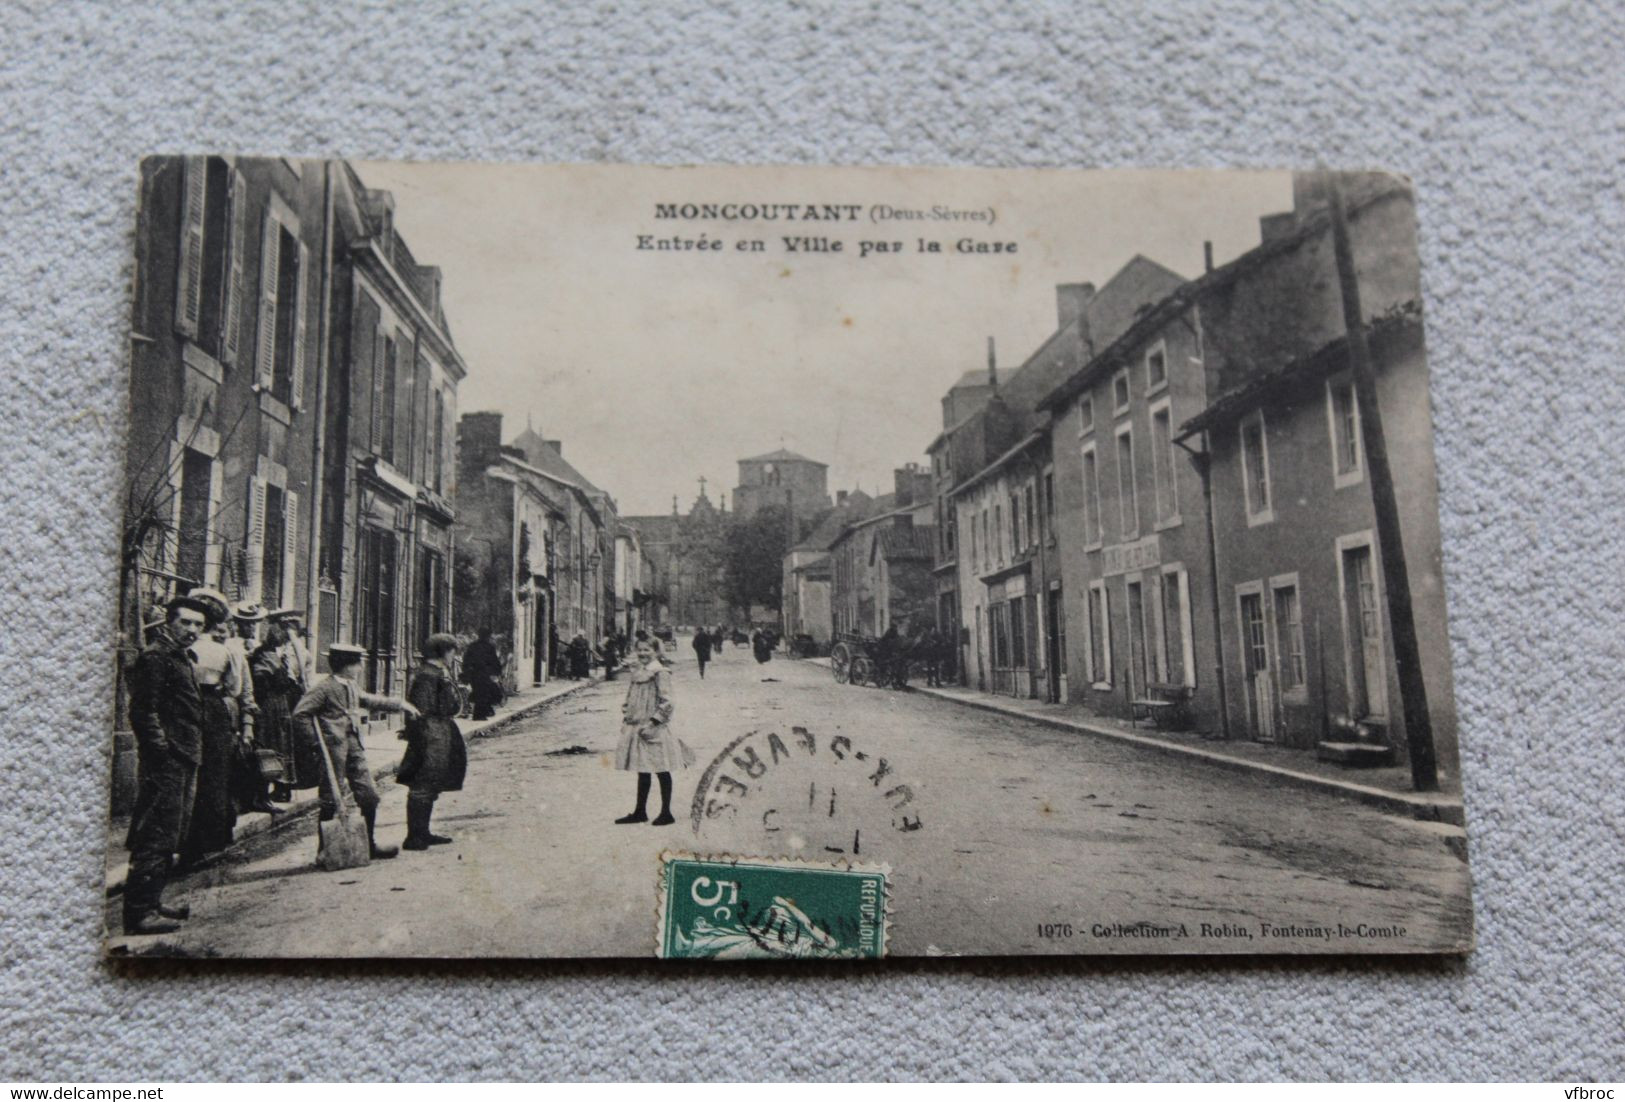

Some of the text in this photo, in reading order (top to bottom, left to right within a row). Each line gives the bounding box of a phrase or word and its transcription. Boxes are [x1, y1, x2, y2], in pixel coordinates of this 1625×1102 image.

[654, 203, 997, 225] MONCOUTANT (Deux-Sèvres)
[636, 233, 1019, 258] Entrée en Ville par la Gare
[1037, 923, 1073, 938] 1976
[1091, 923, 1171, 938] Collection
[1199, 923, 1253, 941] Robin,
[1260, 923, 1407, 942] Fontenay-le-Comte
